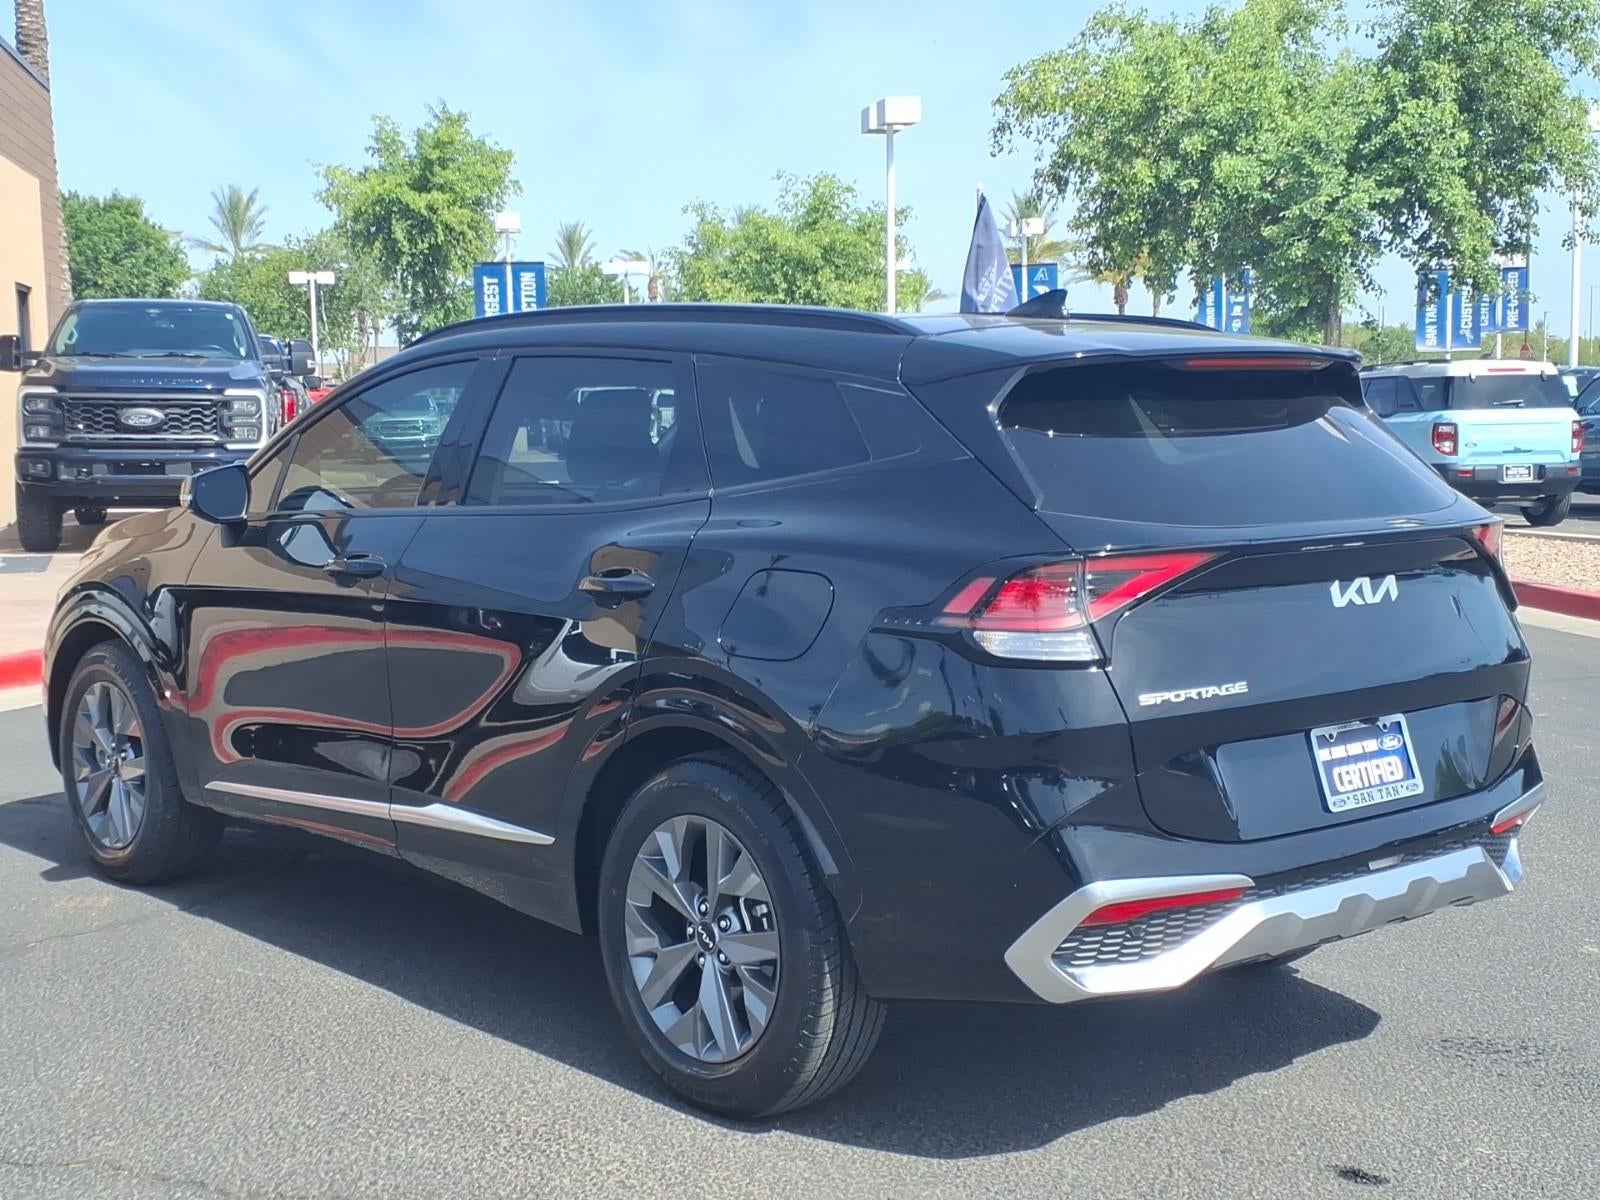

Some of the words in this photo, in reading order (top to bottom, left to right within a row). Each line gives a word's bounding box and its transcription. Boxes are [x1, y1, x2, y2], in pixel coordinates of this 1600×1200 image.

[483, 276, 500, 317] GEST
[1507, 271, 1519, 328] PRE-OED
[1425, 325, 1438, 346] SAN
[1138, 680, 1249, 706] SPORTAGE
